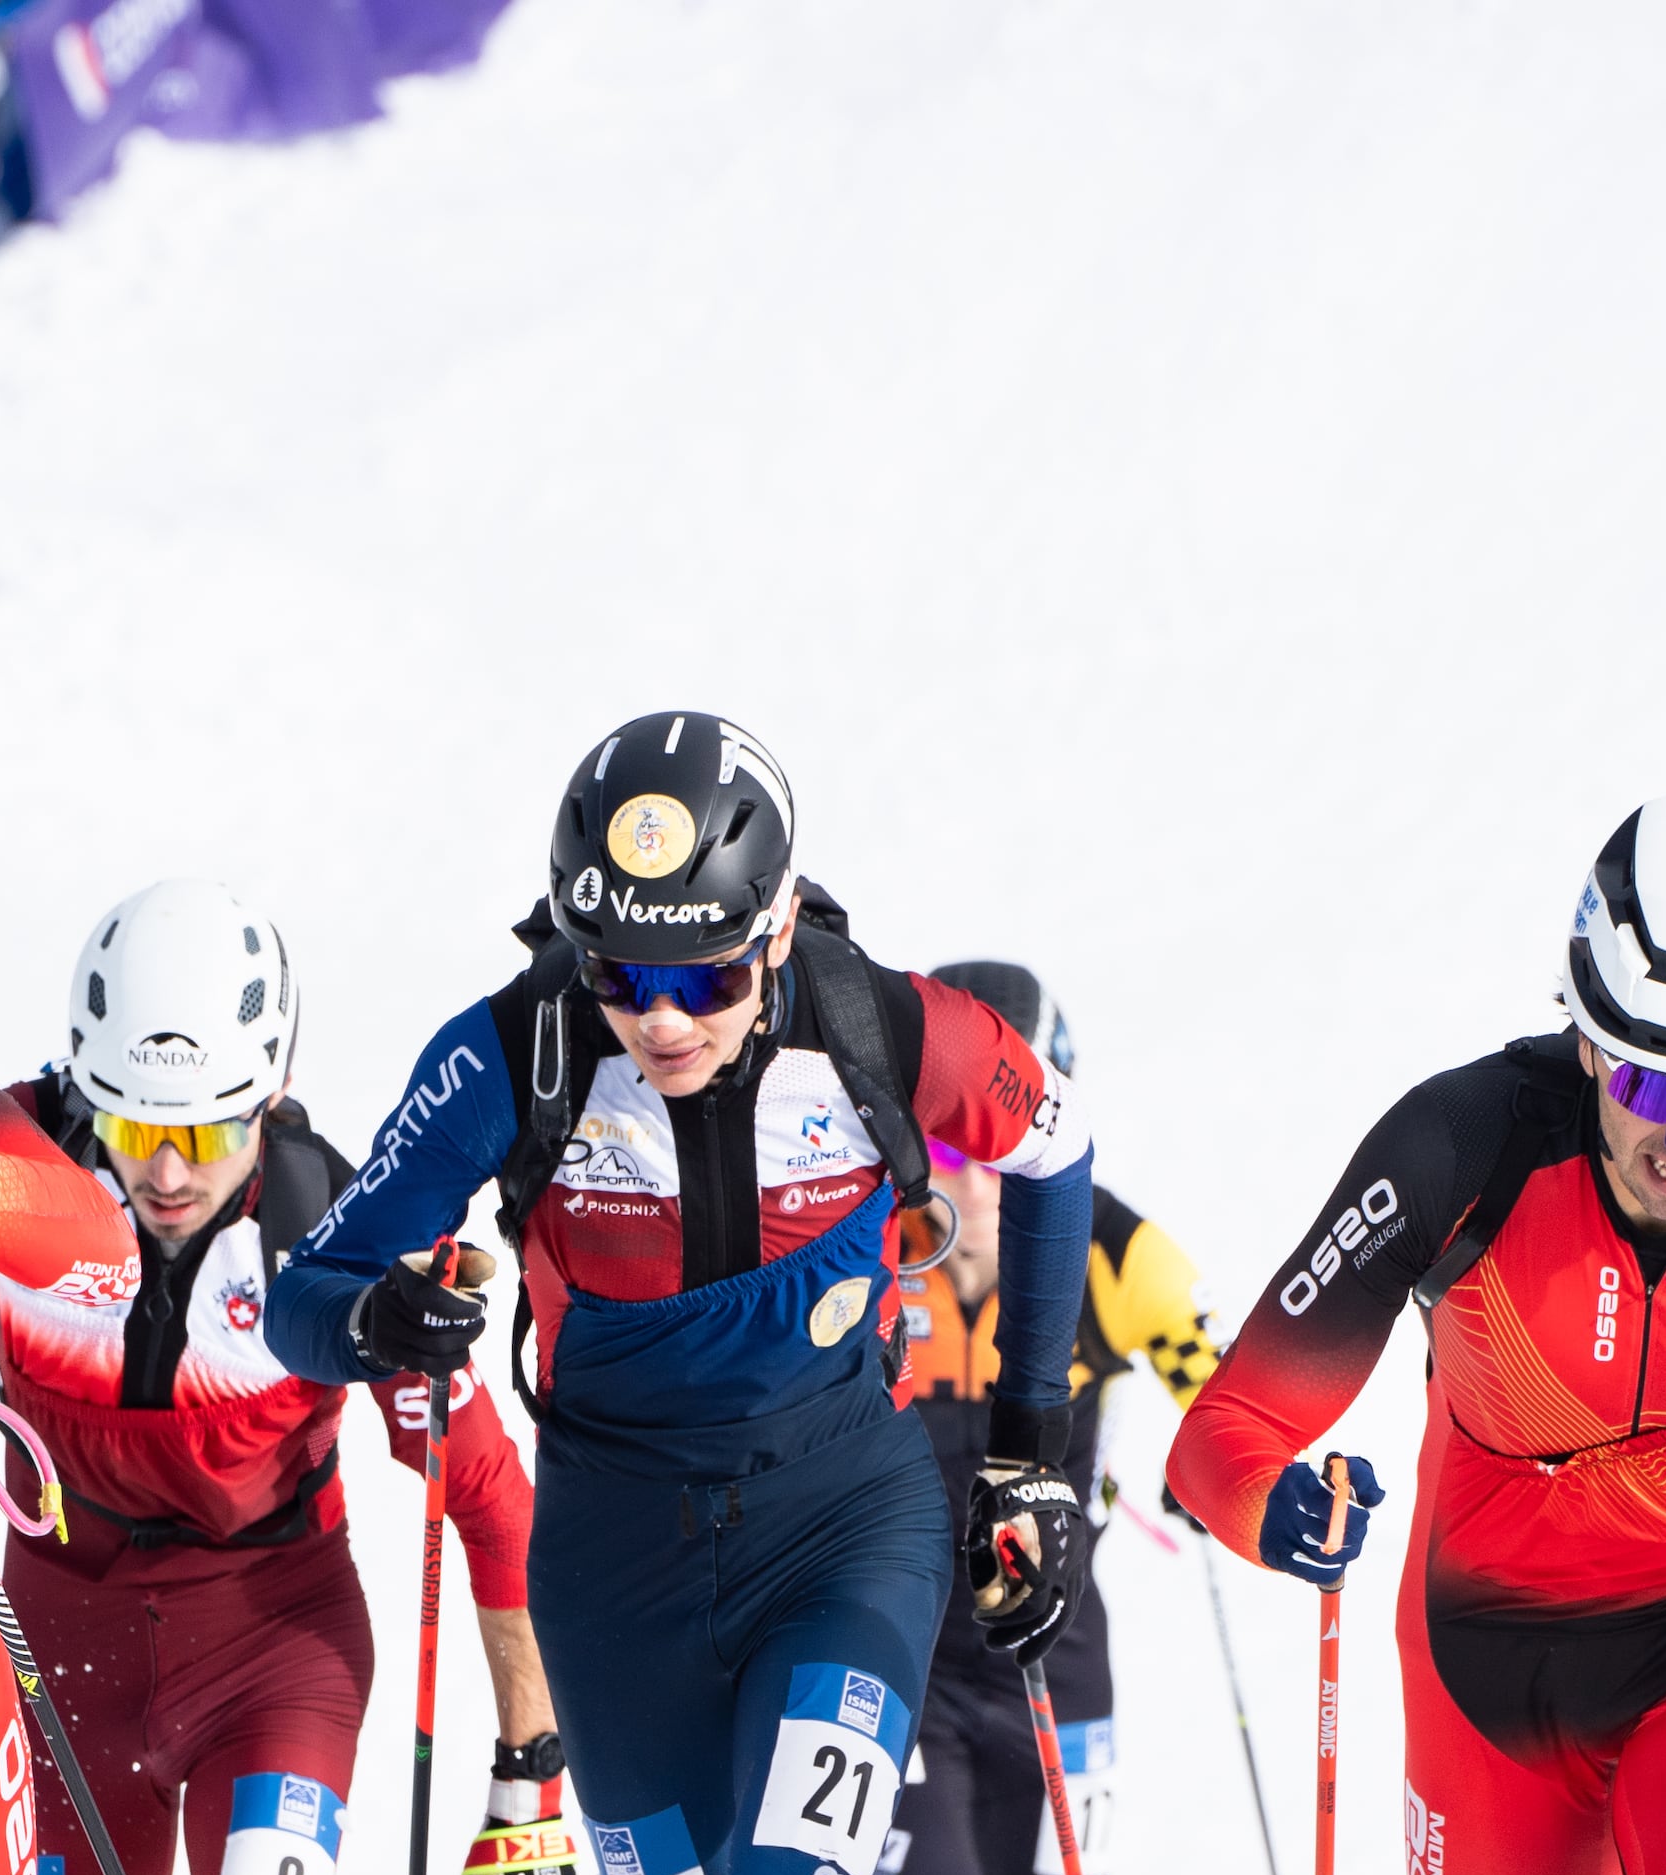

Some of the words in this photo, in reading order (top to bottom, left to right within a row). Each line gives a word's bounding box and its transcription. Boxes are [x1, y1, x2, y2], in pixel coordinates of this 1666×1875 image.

[609, 885, 726, 924] Vercors
[128, 1049, 210, 1067] NENDAZ
[306, 1045, 485, 1252] SPORTIVA
[786, 1146, 852, 1167] FRANCE
[563, 1171, 581, 1183] LA
[585, 1174, 661, 1191] SPORTIVA
[805, 1183, 861, 1205] Vercors
[587, 1201, 661, 1217] PHO3NIX
[1279, 1178, 1398, 1317] OS2O
[1352, 1215, 1407, 1271] FAST&LIGHT
[1593, 1266, 1621, 1362] OS2O
[420, 1518, 444, 1630] ROSSIGNOL
[846, 1693, 878, 1715] ISMF
[1318, 1678, 1338, 1759] ATOMIC
[800, 1744, 874, 1841] 21
[605, 1851, 634, 1864] ISMF
